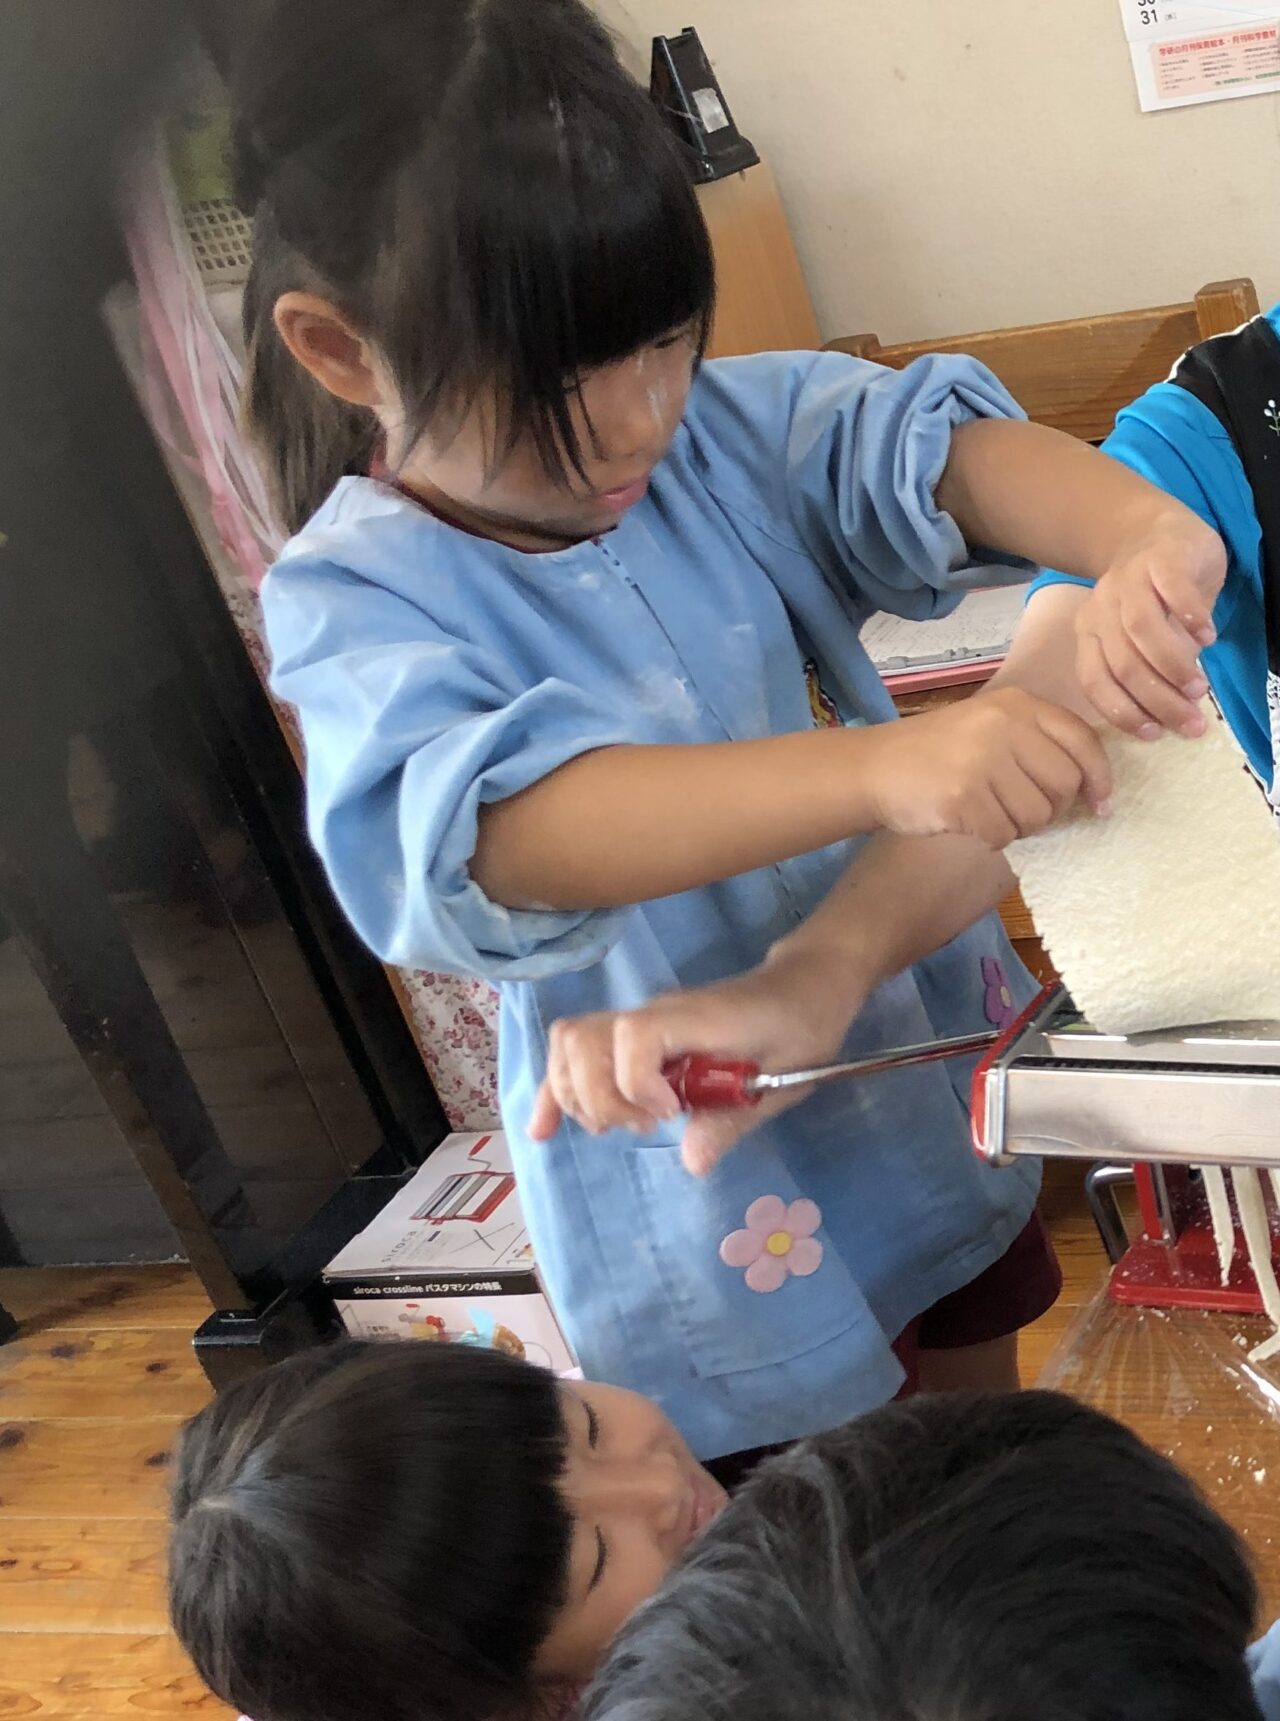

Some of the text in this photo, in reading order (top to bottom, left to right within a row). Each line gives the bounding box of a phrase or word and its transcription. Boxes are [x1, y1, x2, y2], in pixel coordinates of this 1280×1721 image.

[1141, 9, 1158, 25] 31
[353, 1286, 381, 1295] siroca
[383, 1284, 424, 1294] crossline
